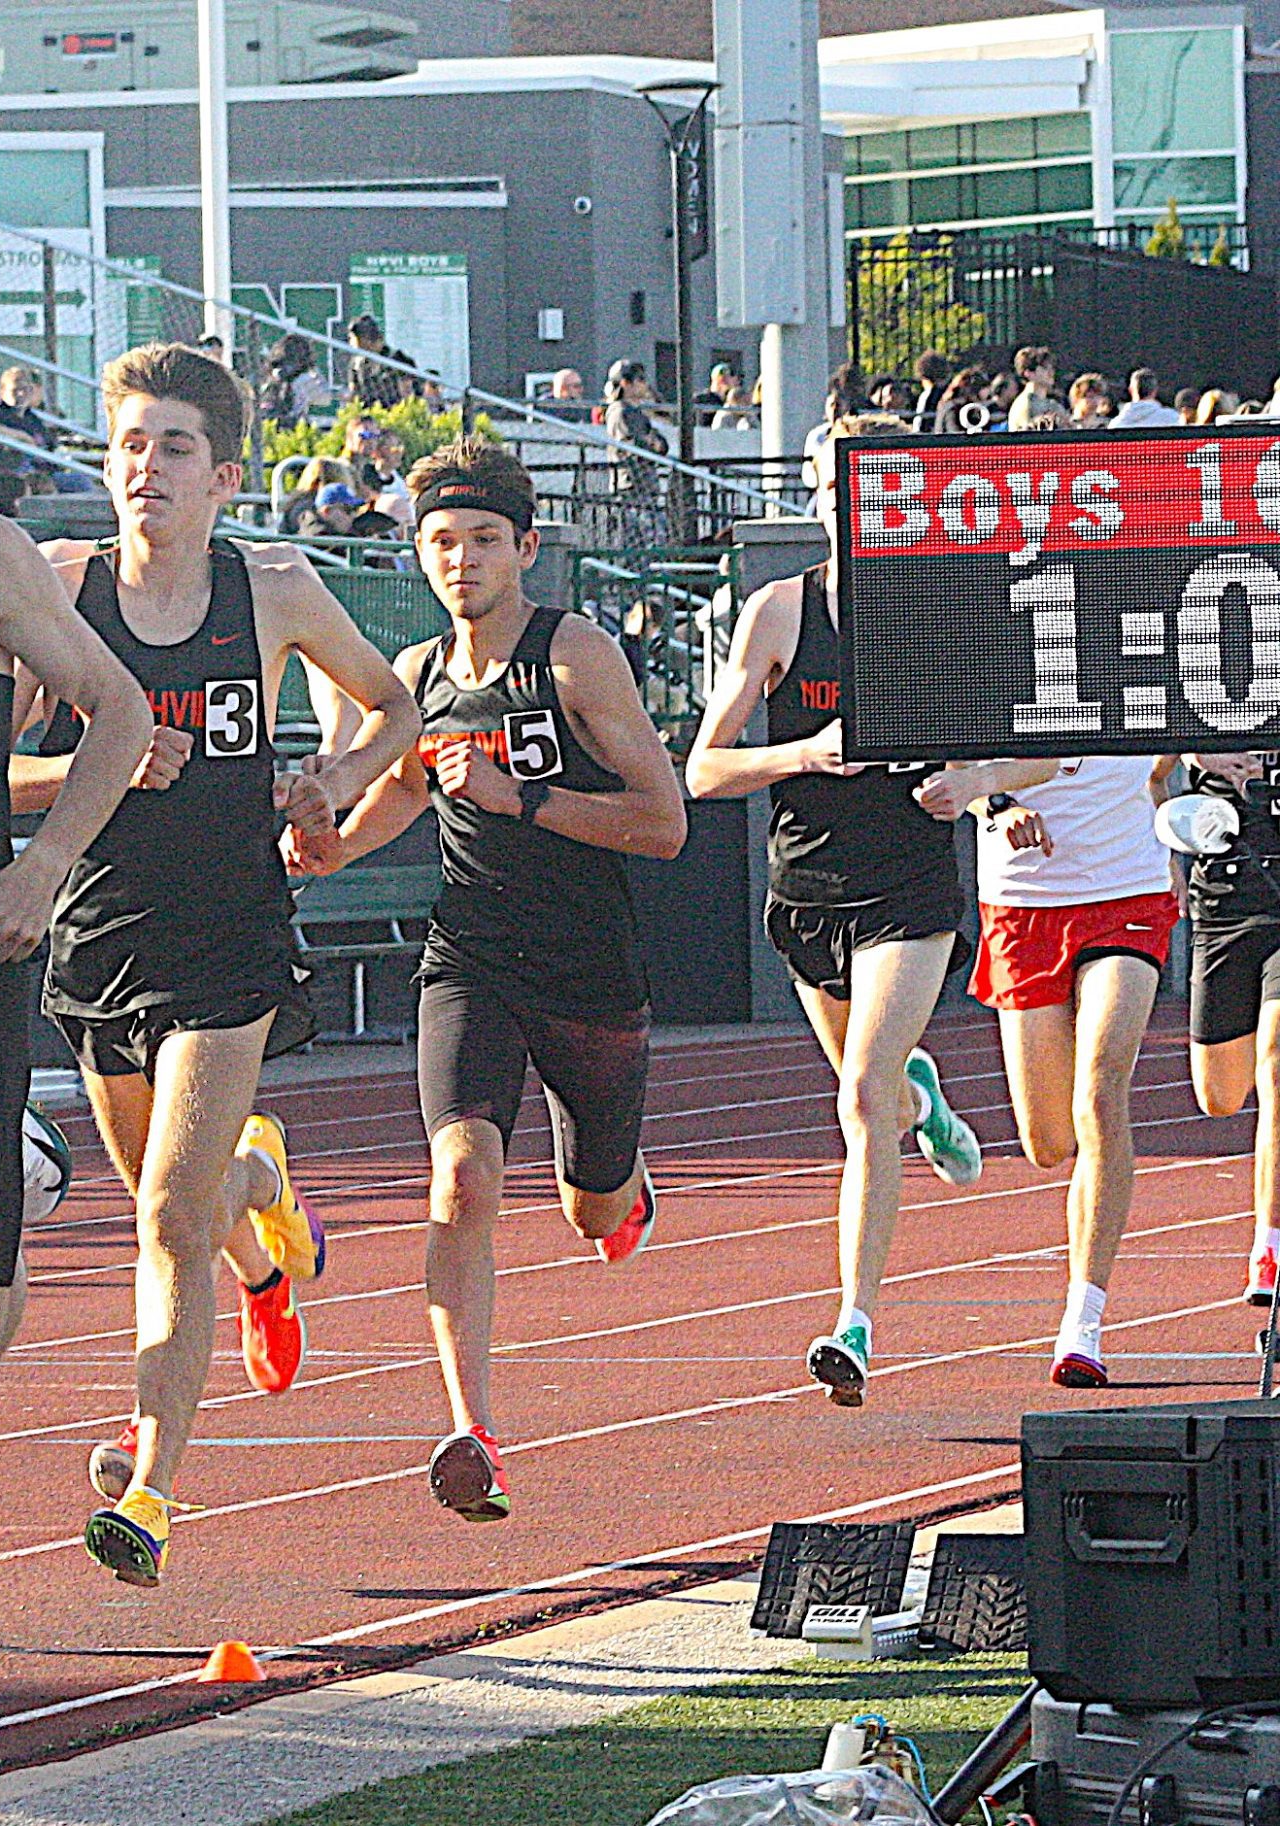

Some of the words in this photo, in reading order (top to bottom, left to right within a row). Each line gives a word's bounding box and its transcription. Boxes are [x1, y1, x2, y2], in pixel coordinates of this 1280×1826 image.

[858, 452, 1125, 566] Boys
[209, 683, 254, 753] 3
[509, 712, 558, 777] 5
[812, 1607, 861, 1617] GILL
